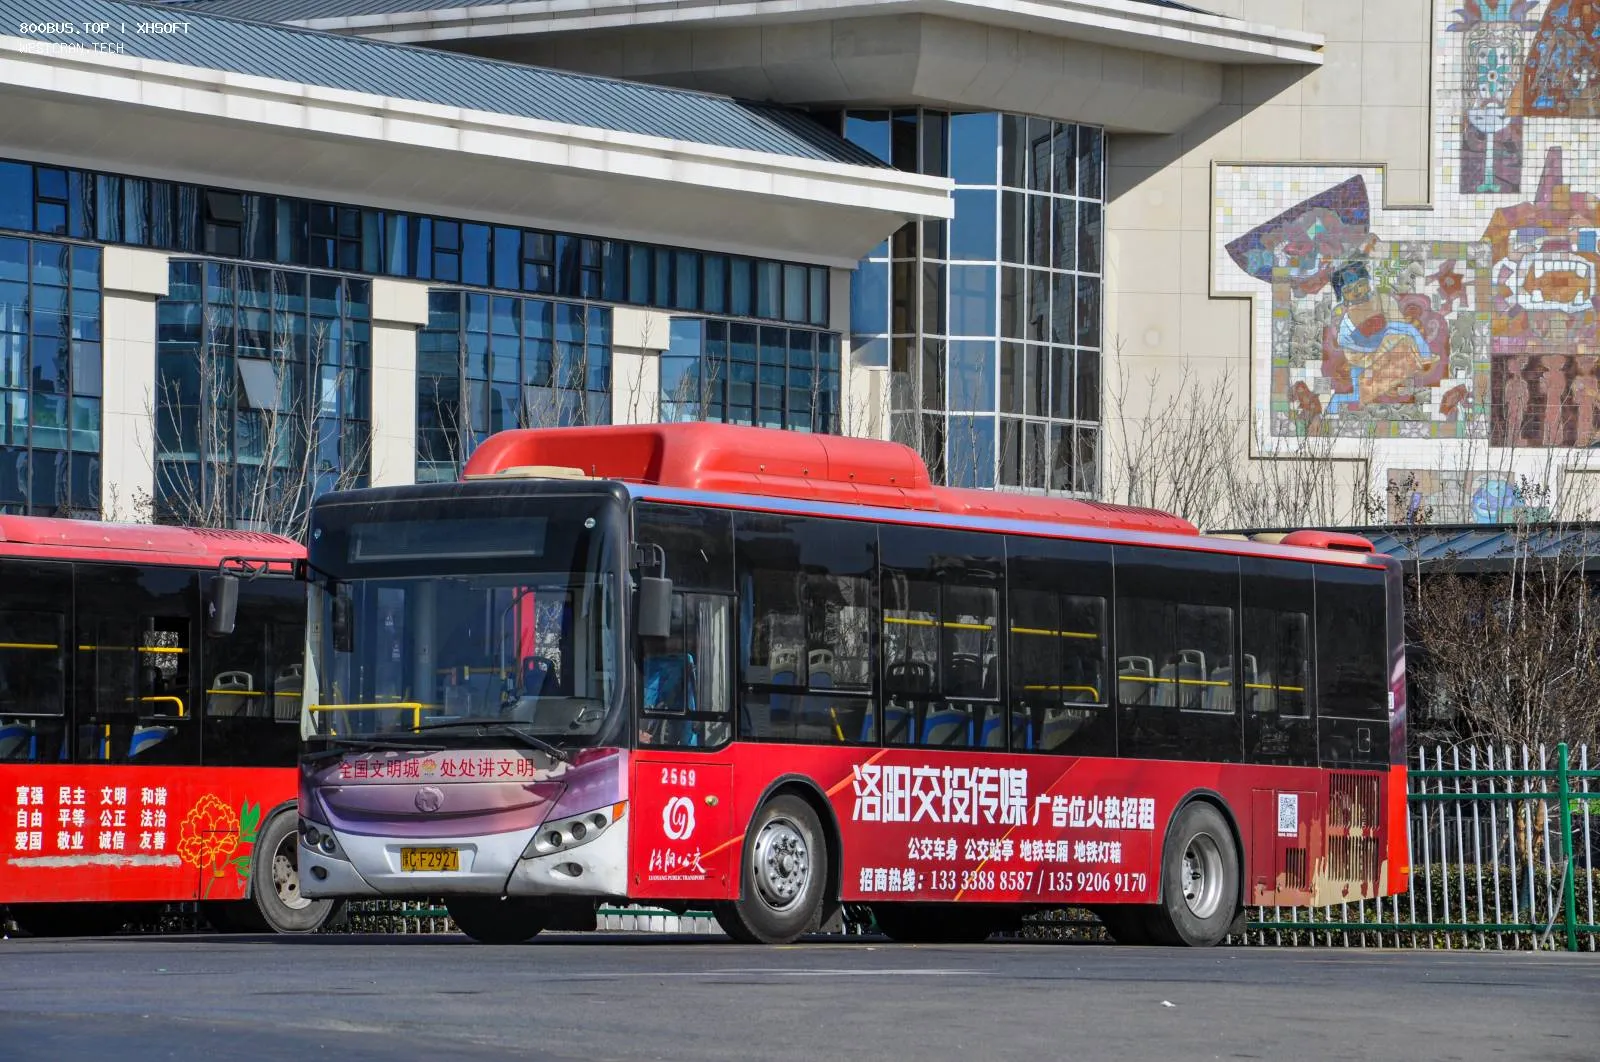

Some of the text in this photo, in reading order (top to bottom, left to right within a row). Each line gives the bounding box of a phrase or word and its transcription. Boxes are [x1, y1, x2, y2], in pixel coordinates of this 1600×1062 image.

[338, 758, 534, 779] 全国文明城 处处讲文明
[661, 767, 696, 787] 2569
[16, 786, 168, 805] 富强 民主 文明 和谐
[852, 763, 1155, 830] 洛阳交投传媒 广告位火热招租
[17, 808, 167, 828] 自由 平等 公正 法治
[15, 831, 166, 850] 爱国 敬业 诚信 友善
[907, 837, 1122, 863] 公交车身 公交站亭 地铁车厢 地铁灯箱
[931, 871, 956, 890] 133
[961, 871, 995, 890] 3388
[999, 871, 1034, 890] 8587
[1048, 872, 1073, 891] 135
[1077, 872, 1111, 892] 9206
[1114, 873, 1147, 892] 9170
